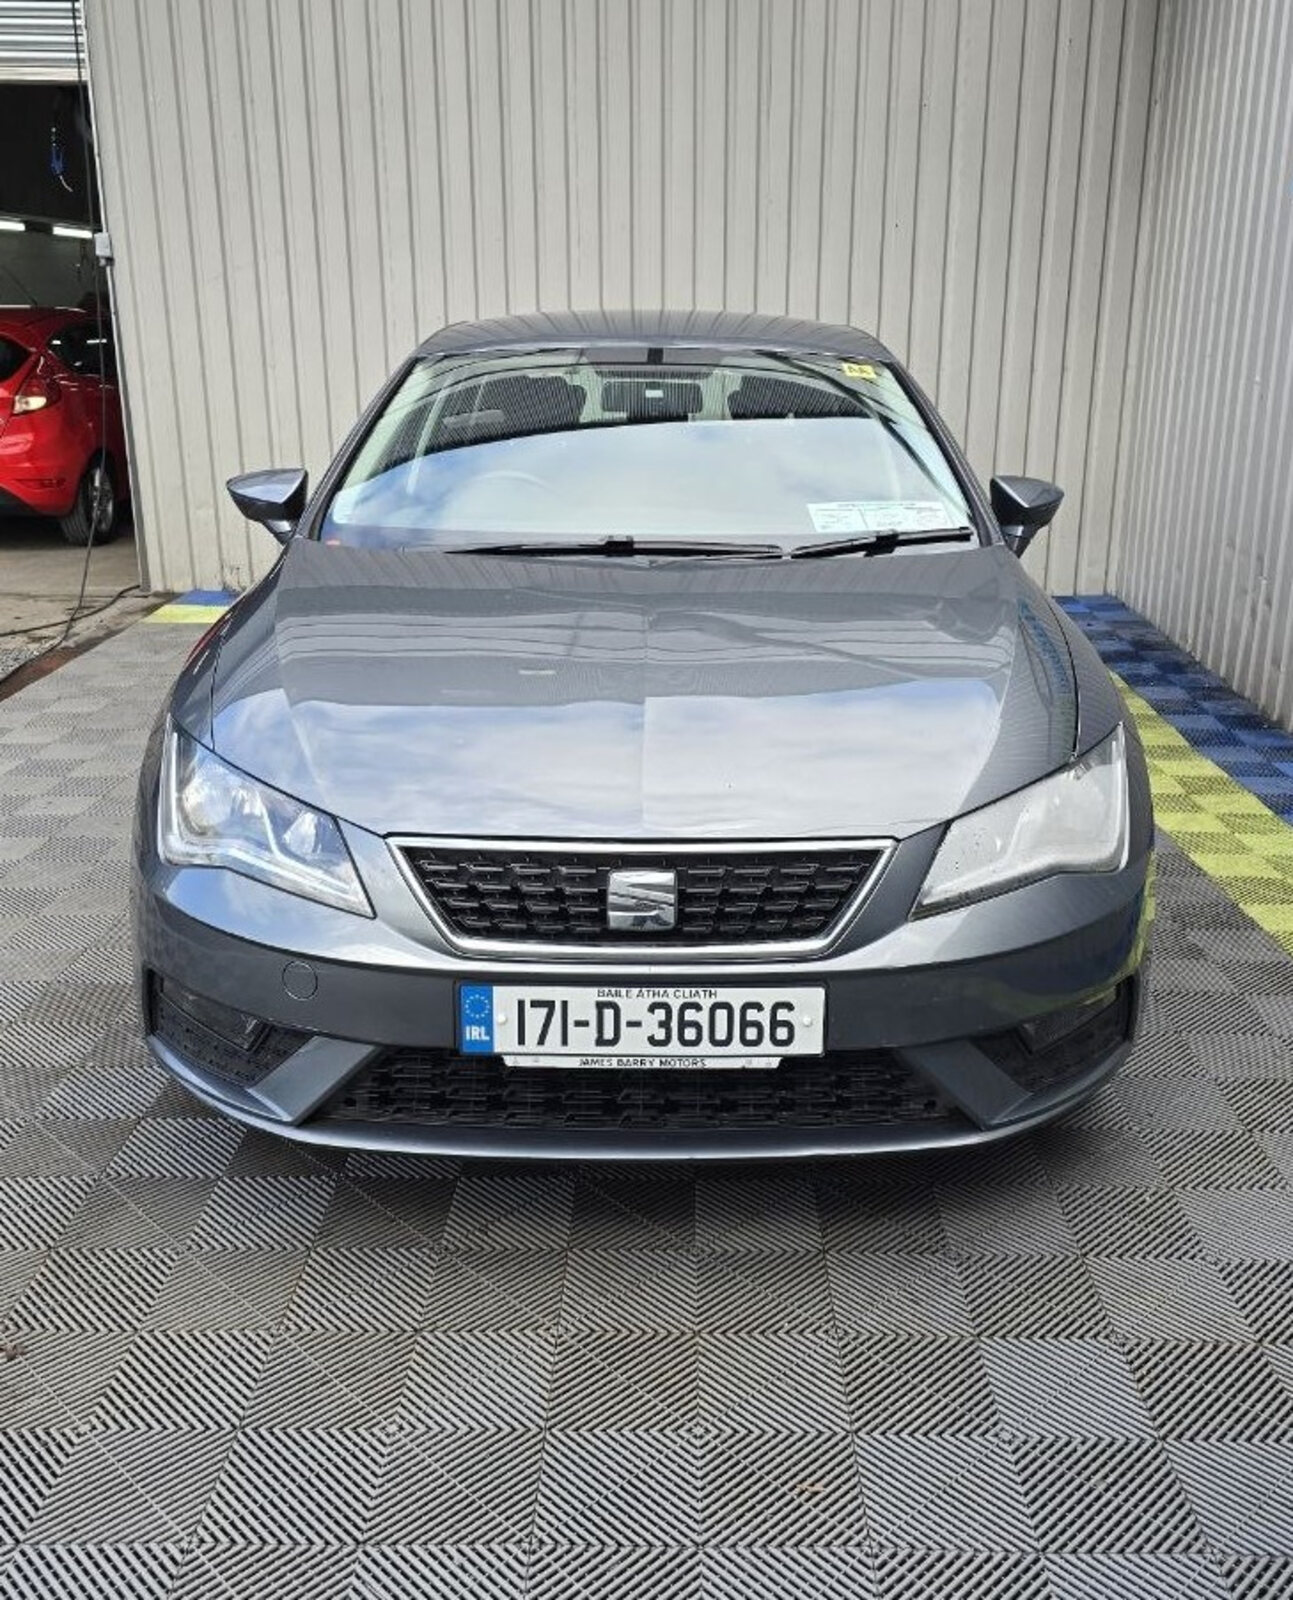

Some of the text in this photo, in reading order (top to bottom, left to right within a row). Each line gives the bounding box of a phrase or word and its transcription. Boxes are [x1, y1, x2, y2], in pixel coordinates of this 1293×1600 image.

[597, 988, 633, 998] BAILE
[673, 988, 718, 999] CLIATH
[516, 999, 795, 1047] 171-D-36066
[465, 1025, 490, 1040] IRL
[579, 1058, 707, 1067] JAMES BARRY MOTORS
